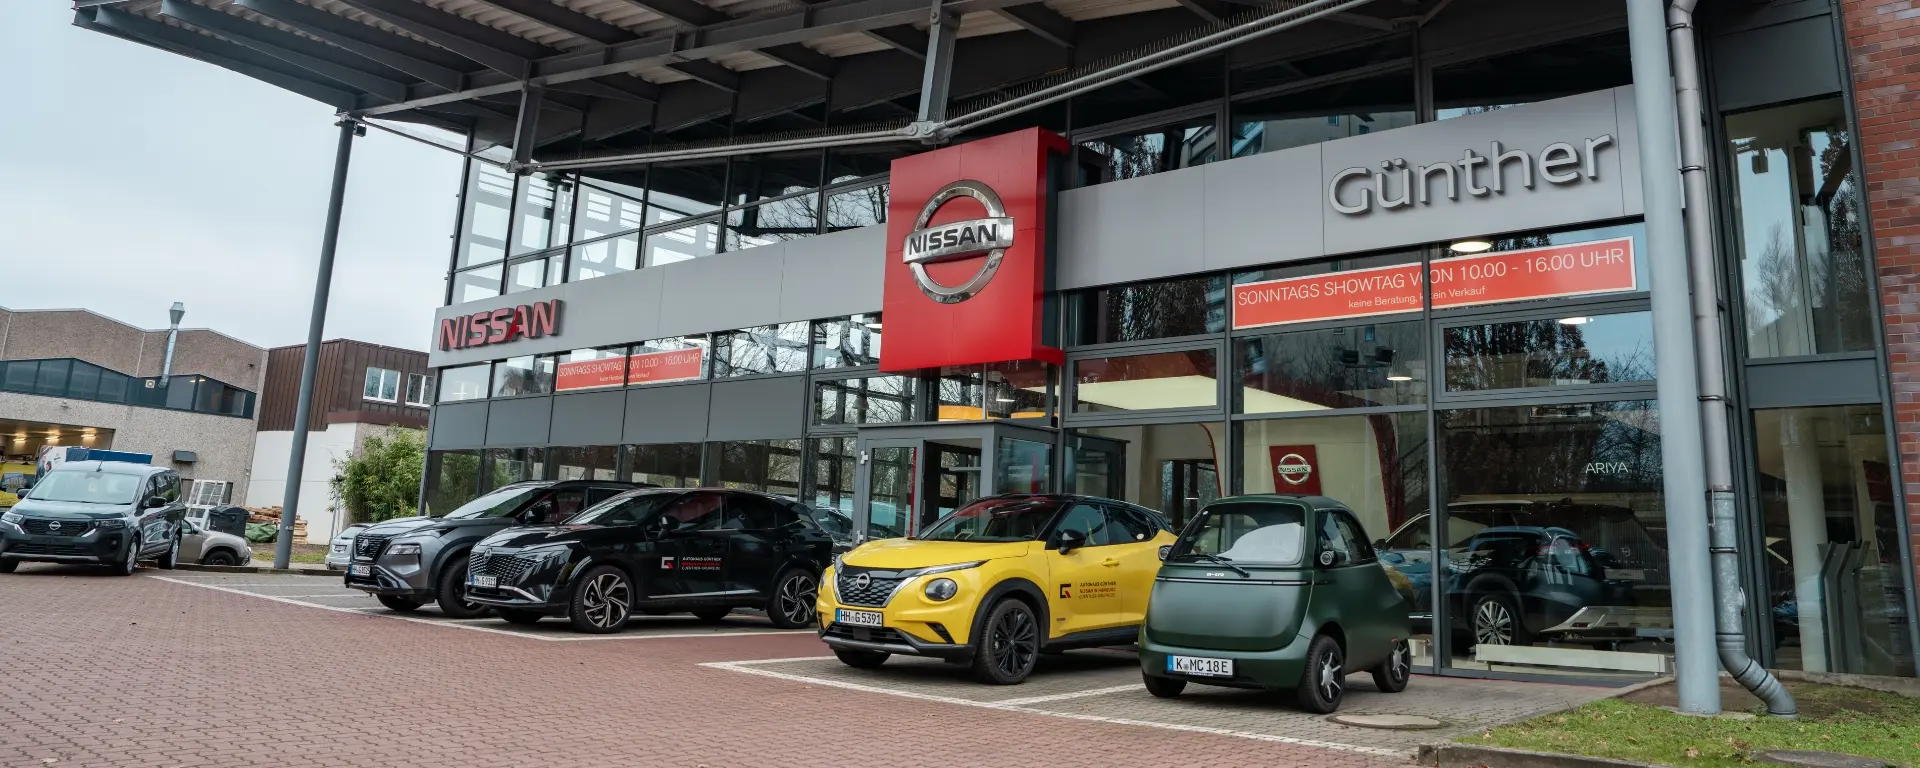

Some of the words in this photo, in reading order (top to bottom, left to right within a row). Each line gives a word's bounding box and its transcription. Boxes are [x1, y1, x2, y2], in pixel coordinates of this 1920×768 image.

[1327, 134, 1614, 215] Günther
[908, 223, 998, 256] NISSAN
[1238, 283, 1320, 306] SONNTAGS
[1323, 273, 1405, 297] SHOWTAG
[1460, 261, 1507, 281] 10.00
[1525, 253, 1576, 274] 16.00
[1580, 247, 1625, 268] UHR
[1348, 298, 1372, 309] keine
[1375, 294, 1418, 308] Beratung,
[1449, 284, 1487, 298] Verkauf
[438, 298, 563, 352] NISSAN
[559, 363, 591, 377] SONNTAGS
[591, 360, 622, 374] SHOWTAG
[683, 352, 700, 364] UHR
[1585, 461, 1629, 474] ARIYA
[840, 610, 851, 622] HH
[1189, 658, 1204, 672] MC
